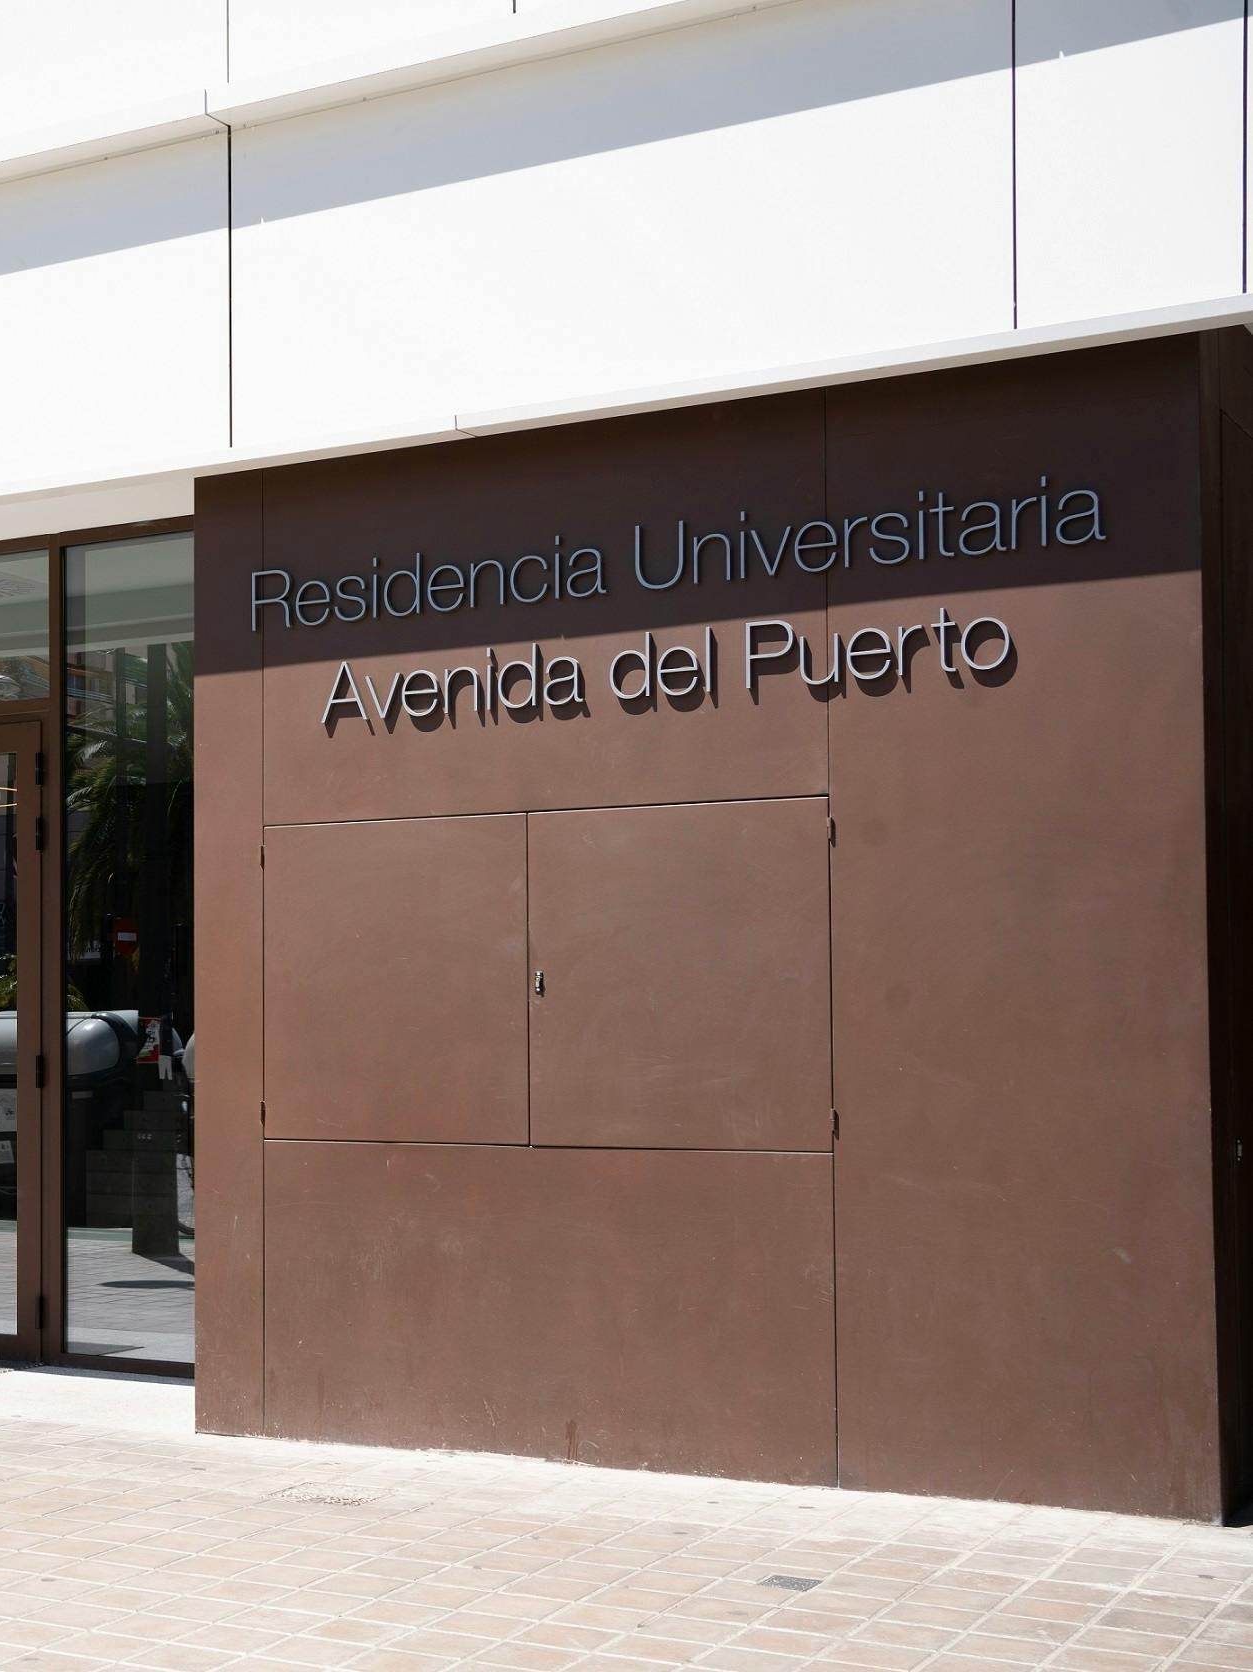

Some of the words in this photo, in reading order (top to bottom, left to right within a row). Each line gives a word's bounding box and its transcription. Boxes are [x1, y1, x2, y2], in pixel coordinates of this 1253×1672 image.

[250, 535, 607, 631] Residencia
[634, 476, 1106, 590] Universitaria
[320, 642, 585, 724] Avenida
[610, 626, 713, 698] del
[745, 607, 1012, 690] Puerto
